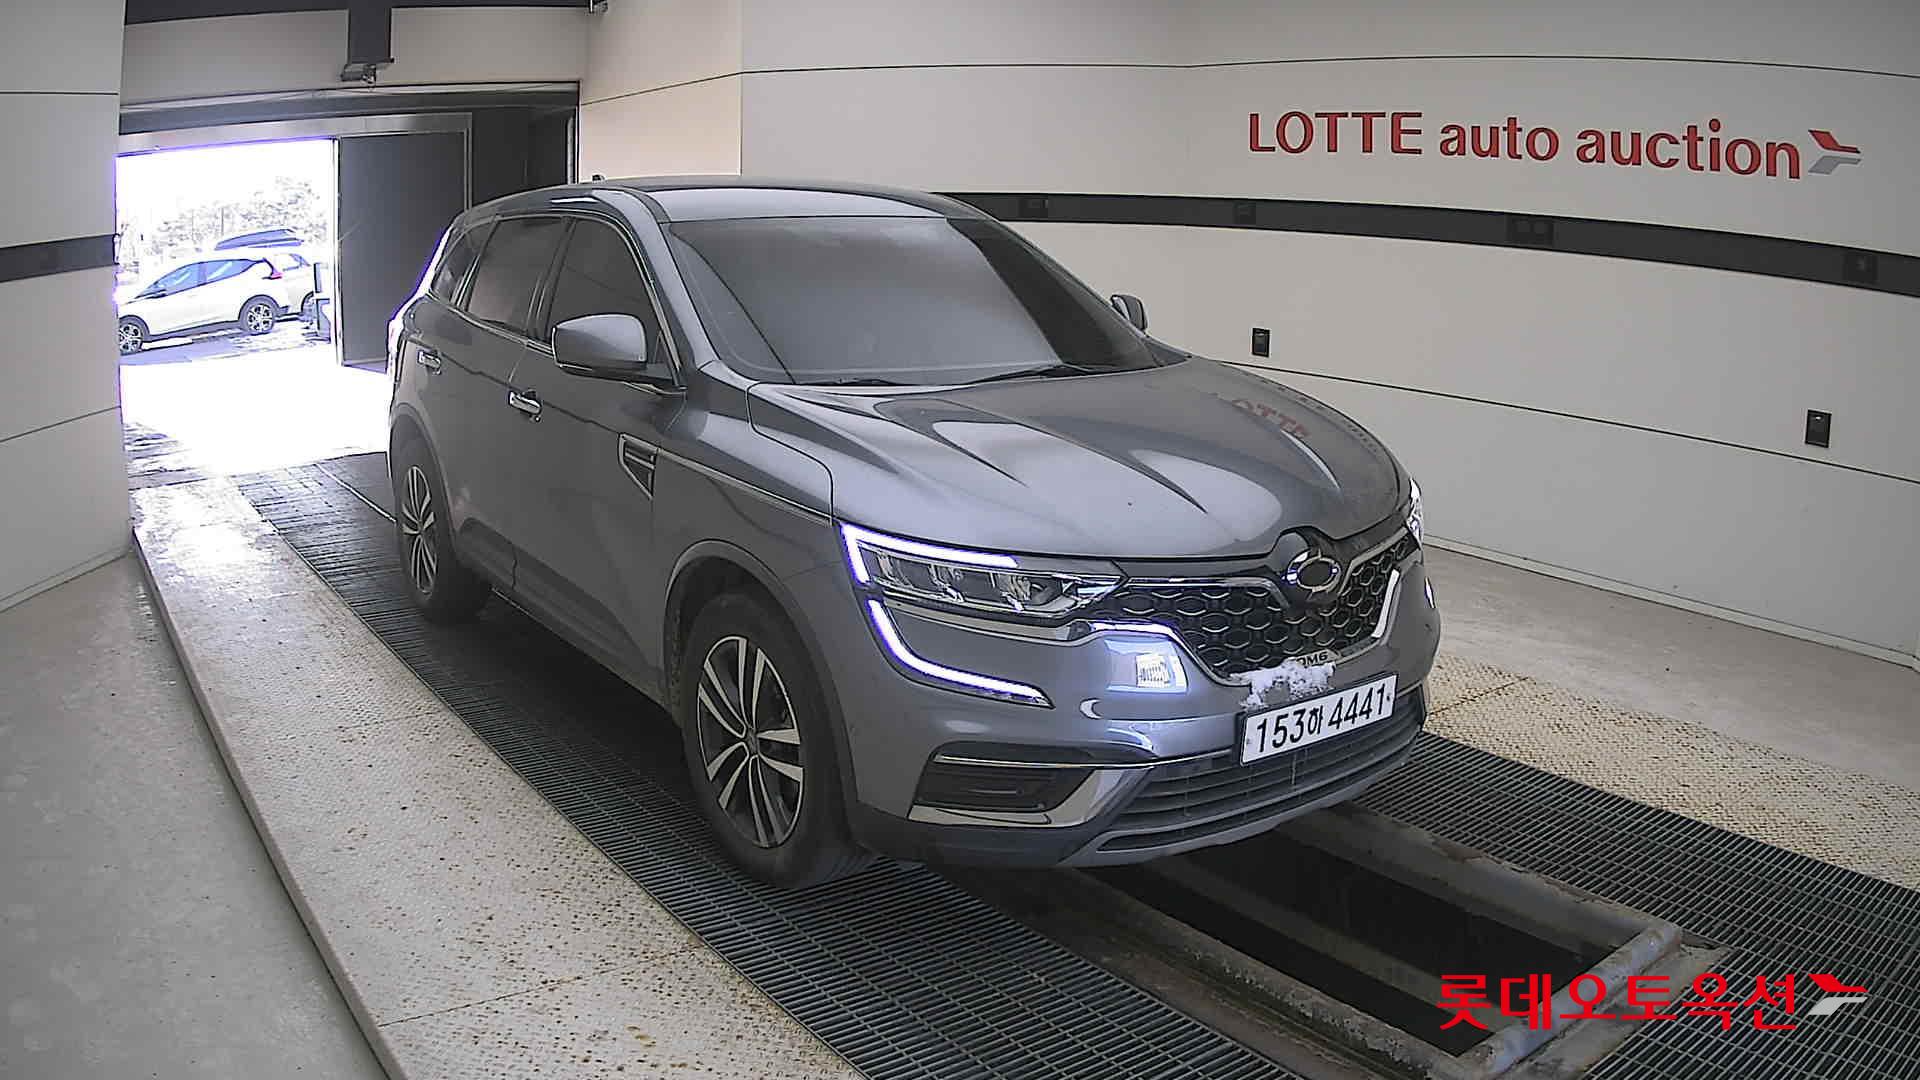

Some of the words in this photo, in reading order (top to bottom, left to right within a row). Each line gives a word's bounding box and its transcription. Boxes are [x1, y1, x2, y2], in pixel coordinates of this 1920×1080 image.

[1249, 112, 1423, 154] LOTTE
[1440, 117, 1560, 160] auto
[1576, 119, 1801, 179] auction
[1257, 705, 1323, 753] 153하
[1328, 683, 1386, 729] 4441
